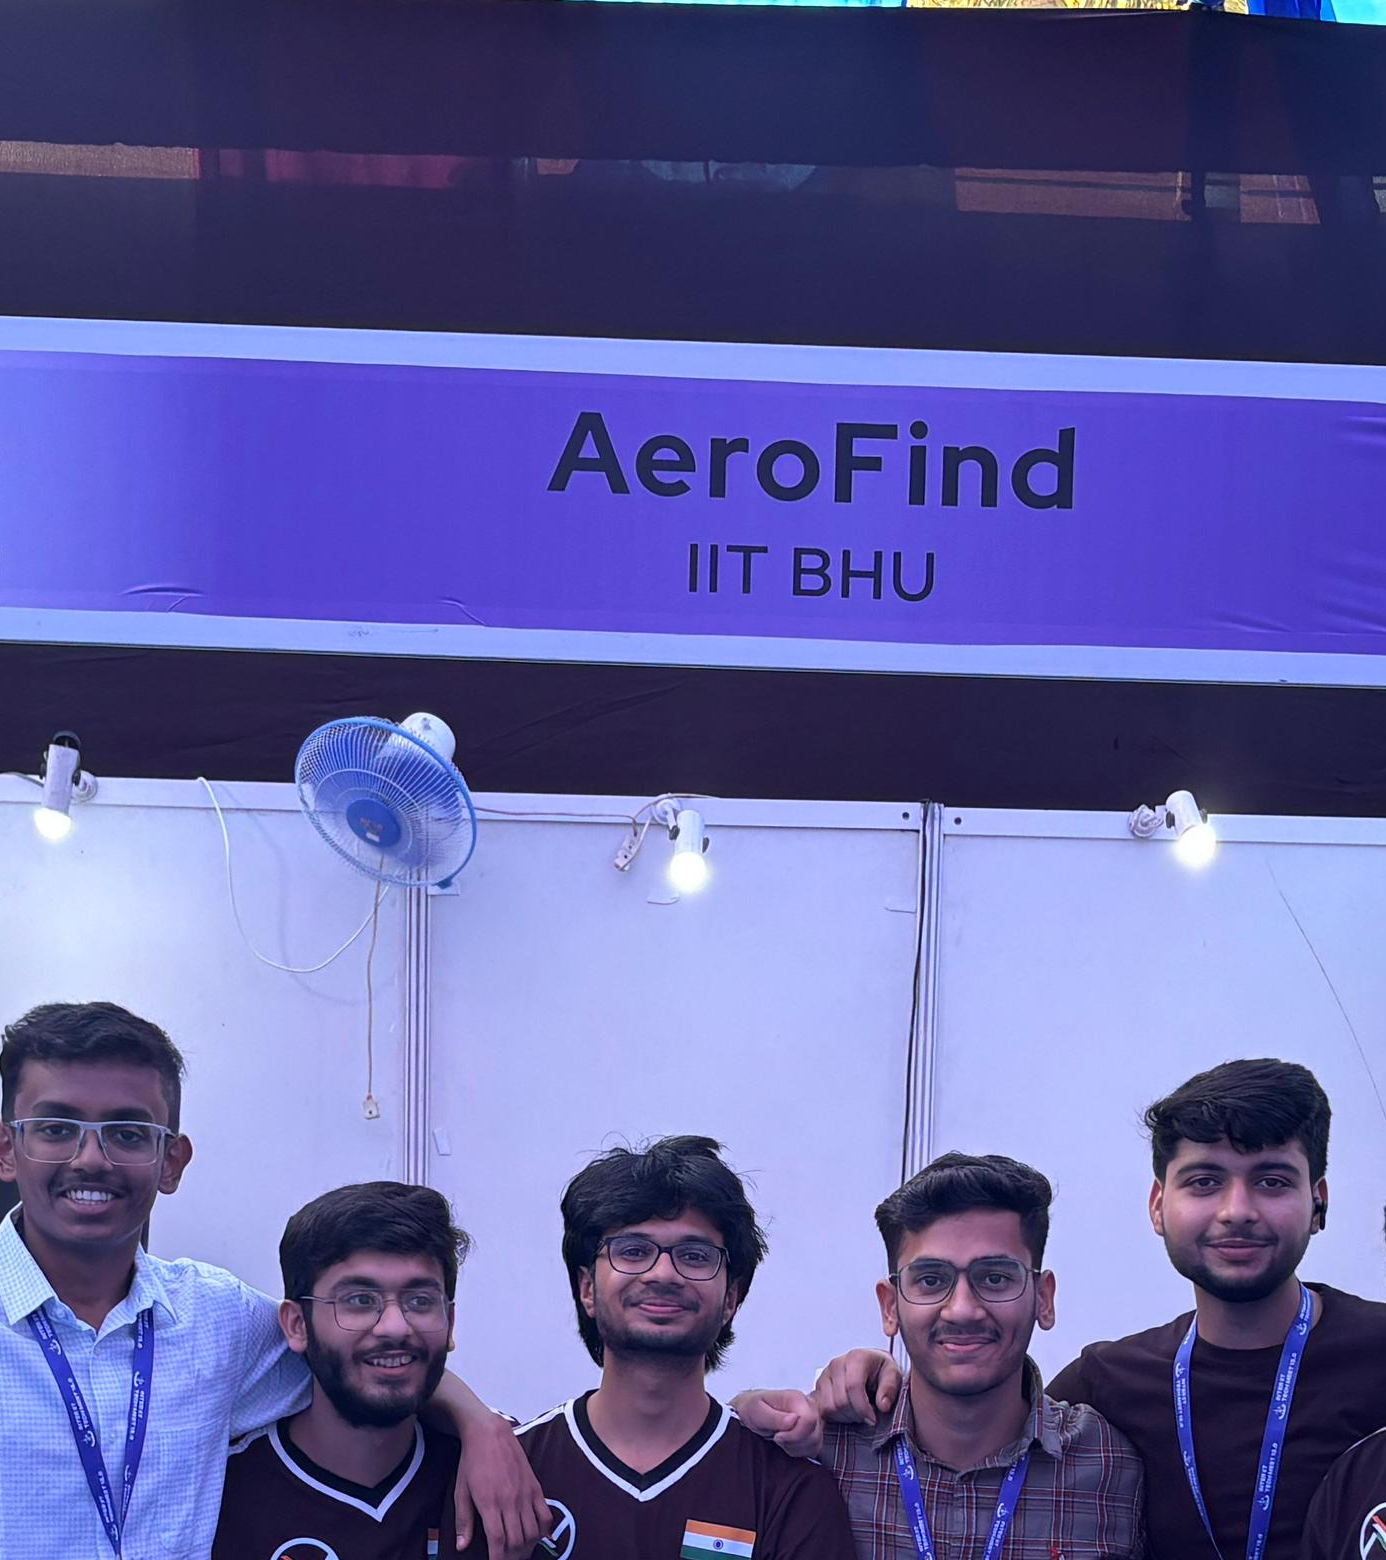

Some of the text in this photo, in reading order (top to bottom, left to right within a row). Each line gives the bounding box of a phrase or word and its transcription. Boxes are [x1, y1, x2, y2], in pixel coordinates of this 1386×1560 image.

[546, 410, 1078, 512] AeroFind
[687, 542, 936, 601] IIT BHU
